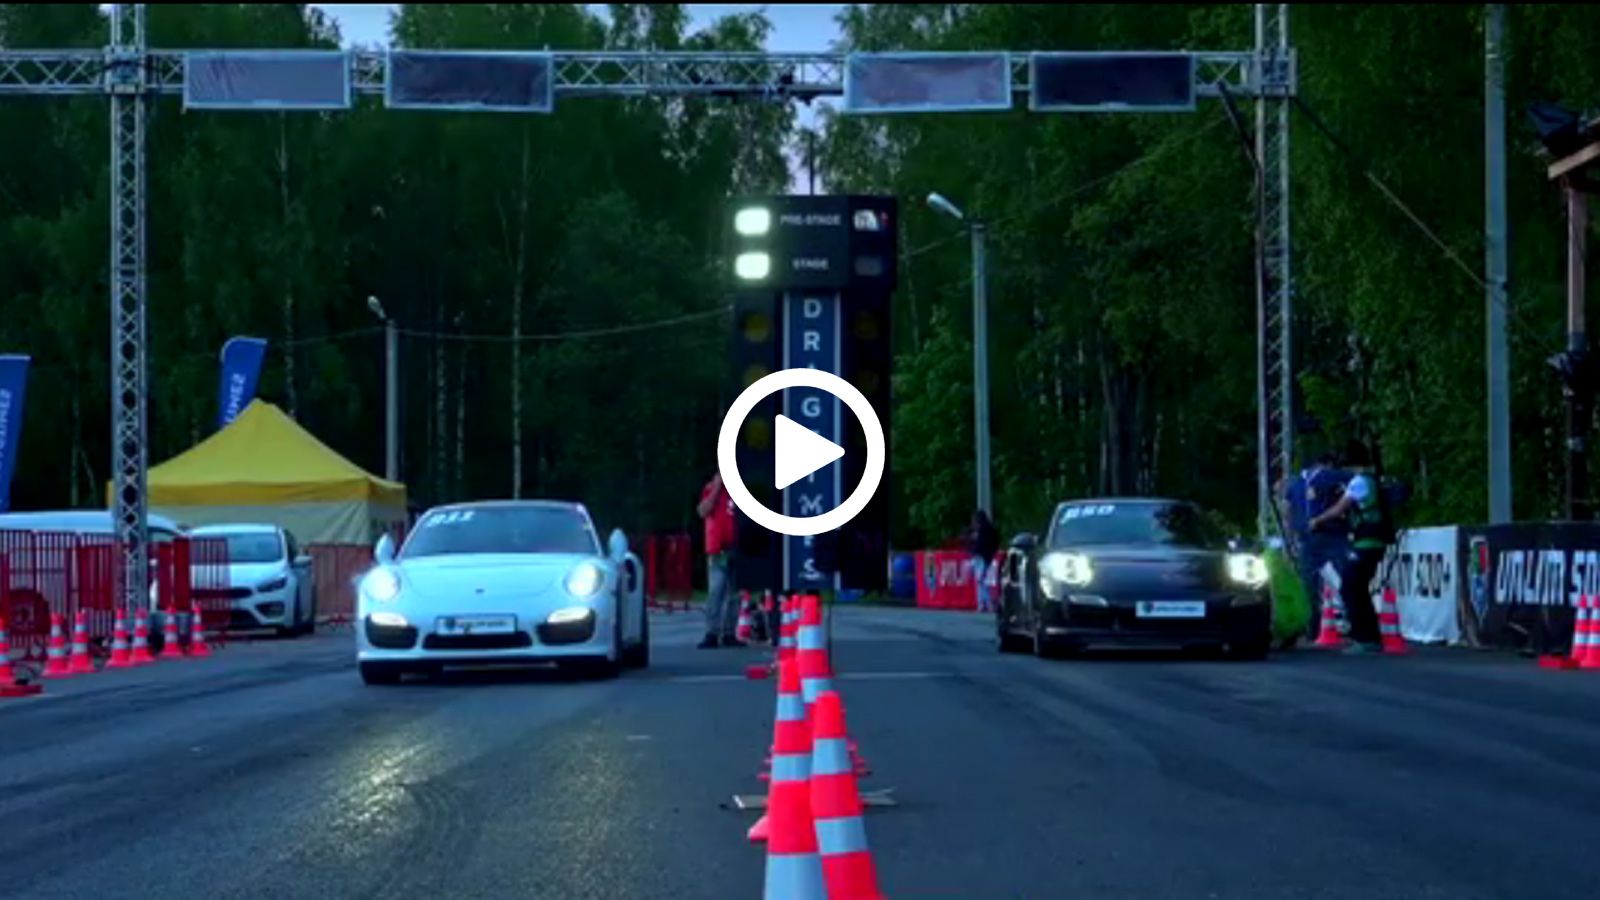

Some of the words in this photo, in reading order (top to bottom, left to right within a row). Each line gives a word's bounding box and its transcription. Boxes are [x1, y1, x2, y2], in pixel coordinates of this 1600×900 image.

[780, 213, 842, 226] PRE-STAGE
[792, 256, 829, 270] STAGE
[1495, 549, 1565, 605] UNLIM
